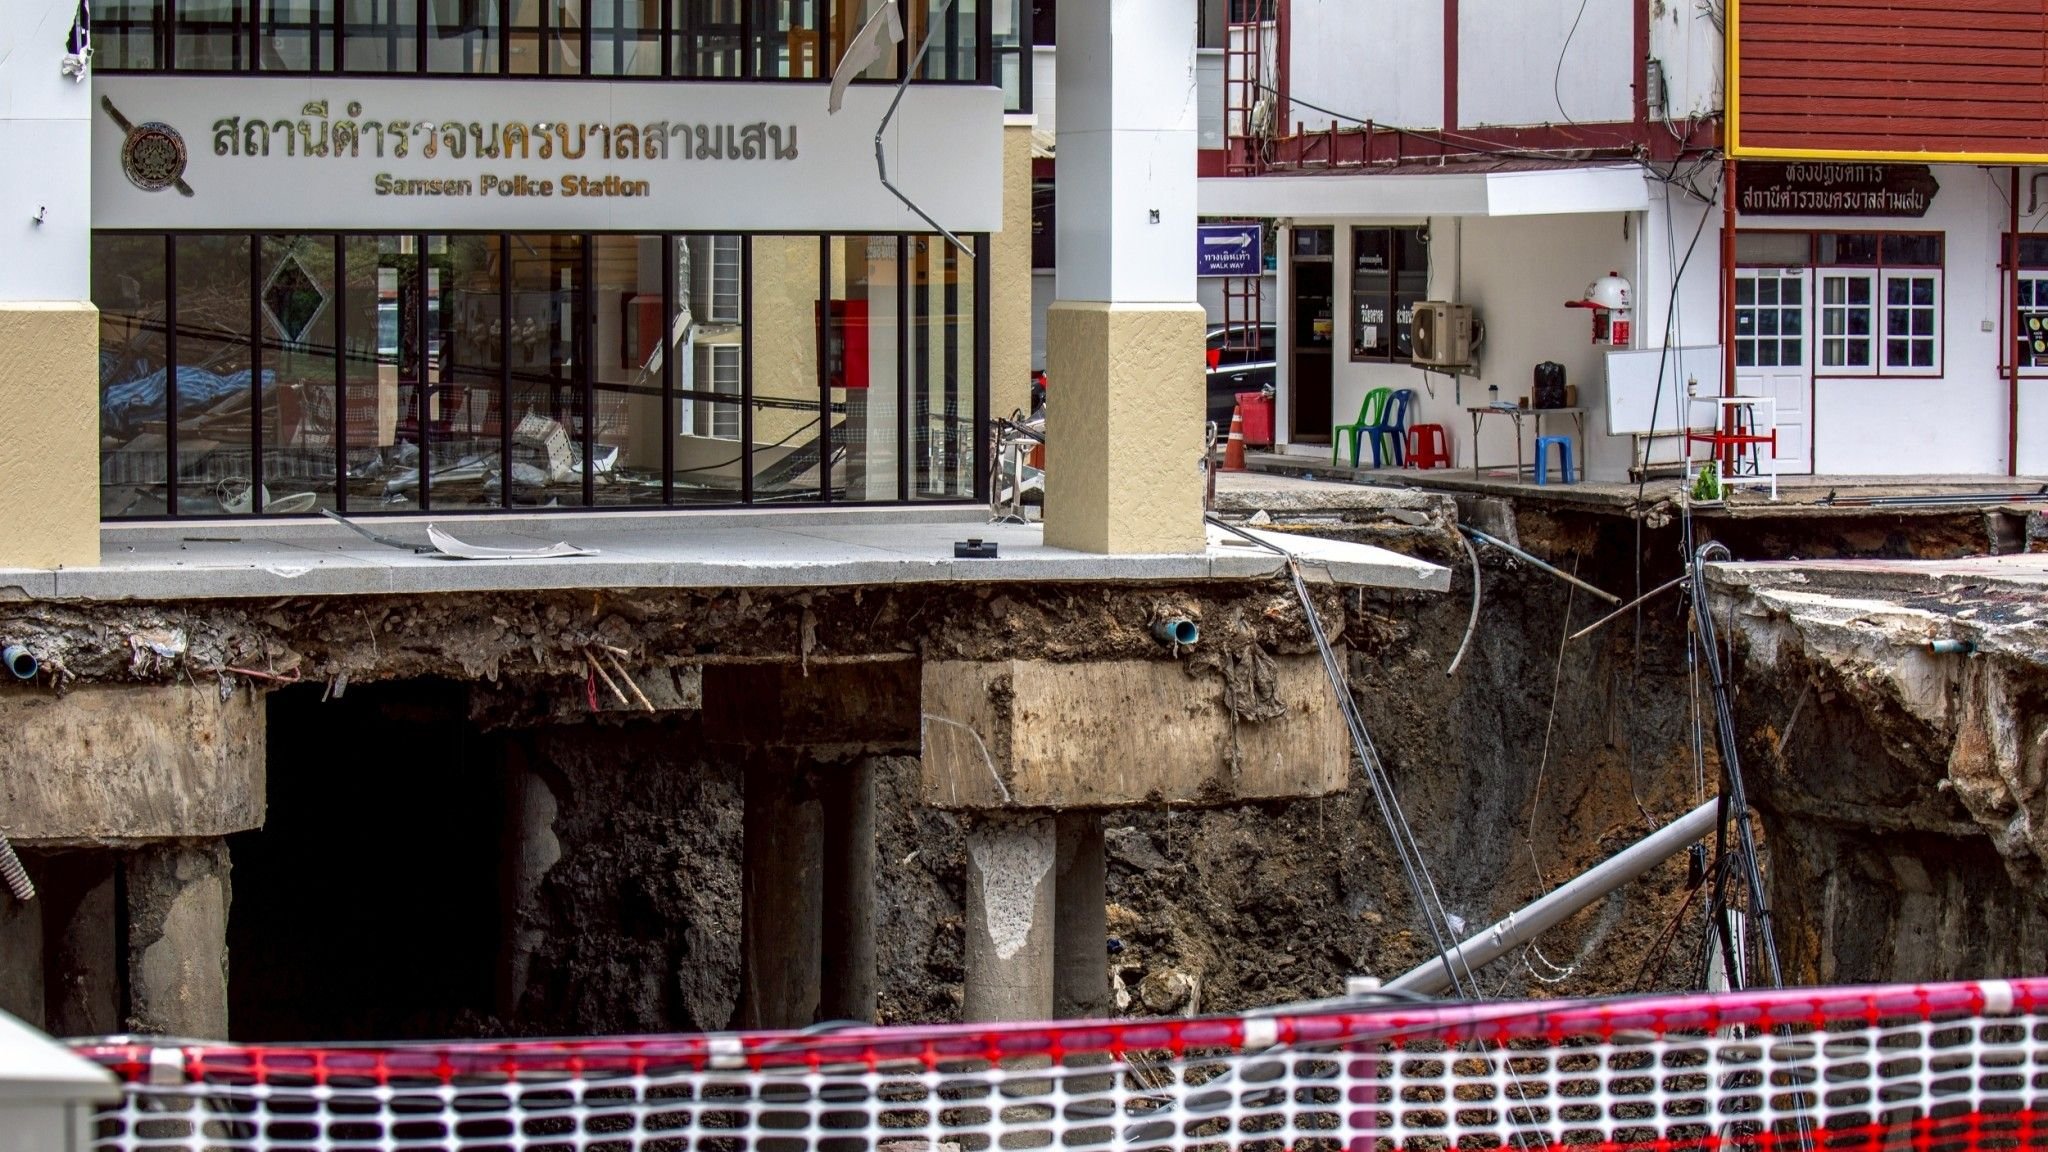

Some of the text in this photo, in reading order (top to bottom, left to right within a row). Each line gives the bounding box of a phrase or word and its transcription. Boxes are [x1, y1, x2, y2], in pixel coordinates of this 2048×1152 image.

[212, 99, 798, 160] สถานีตำรวจนครบาลสามเสน
[375, 172, 650, 197] Samsen Police Station
[1785, 162, 1883, 186] หองปฏบตการ
[1743, 185, 1924, 210] สถานีตำรวจนครบาลสามเสน
[1204, 250, 1250, 261] ทางเดินเท้า
